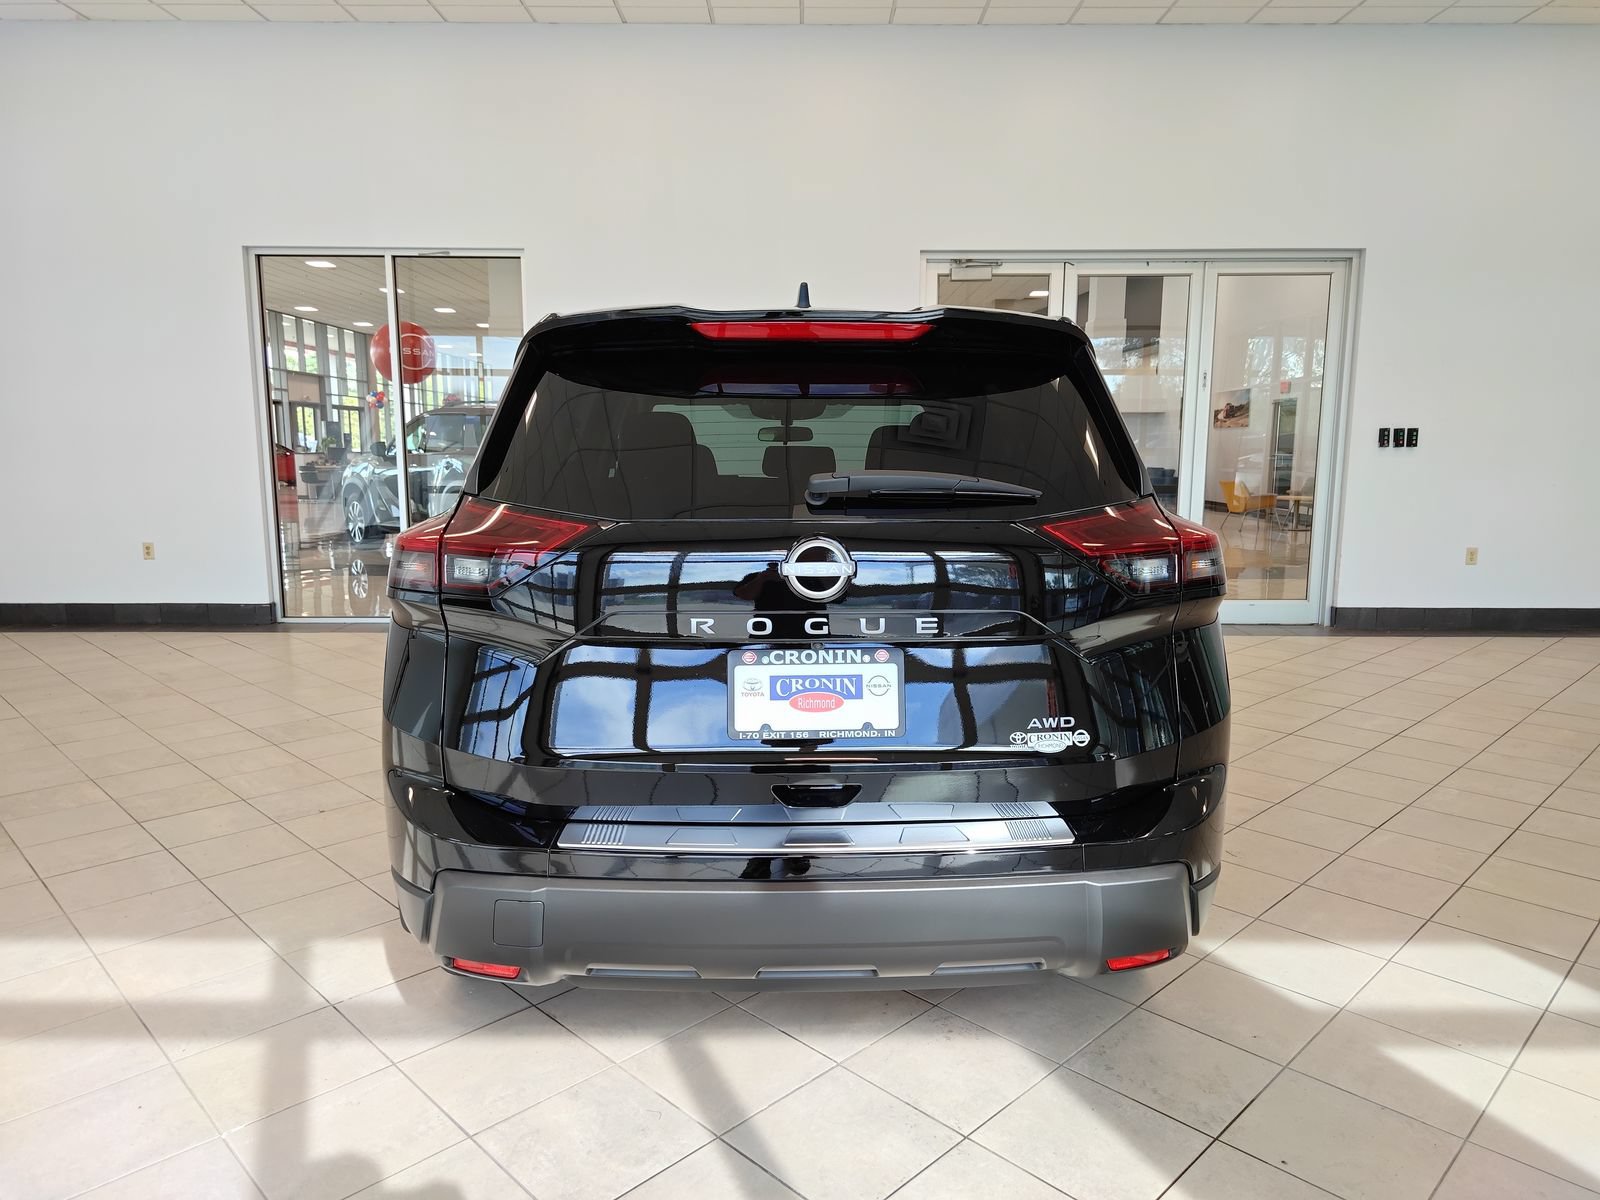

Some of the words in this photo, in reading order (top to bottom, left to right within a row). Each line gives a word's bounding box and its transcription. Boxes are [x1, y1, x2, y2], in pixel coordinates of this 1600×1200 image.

[403, 347, 434, 357] SSAN
[784, 563, 852, 574] NISSAN
[690, 617, 940, 635] ROGUE
[769, 649, 862, 664] CRONIN
[776, 677, 857, 696] CRONIN
[797, 697, 836, 709] Richmond
[1027, 716, 1076, 729] AWD
[739, 732, 760, 740] I-70
[763, 731, 786, 739] EXIT
[790, 731, 809, 739] 156
[819, 730, 881, 738] RICHMOND,
[884, 729, 896, 737] IN
[1029, 732, 1071, 743] CRONIN
